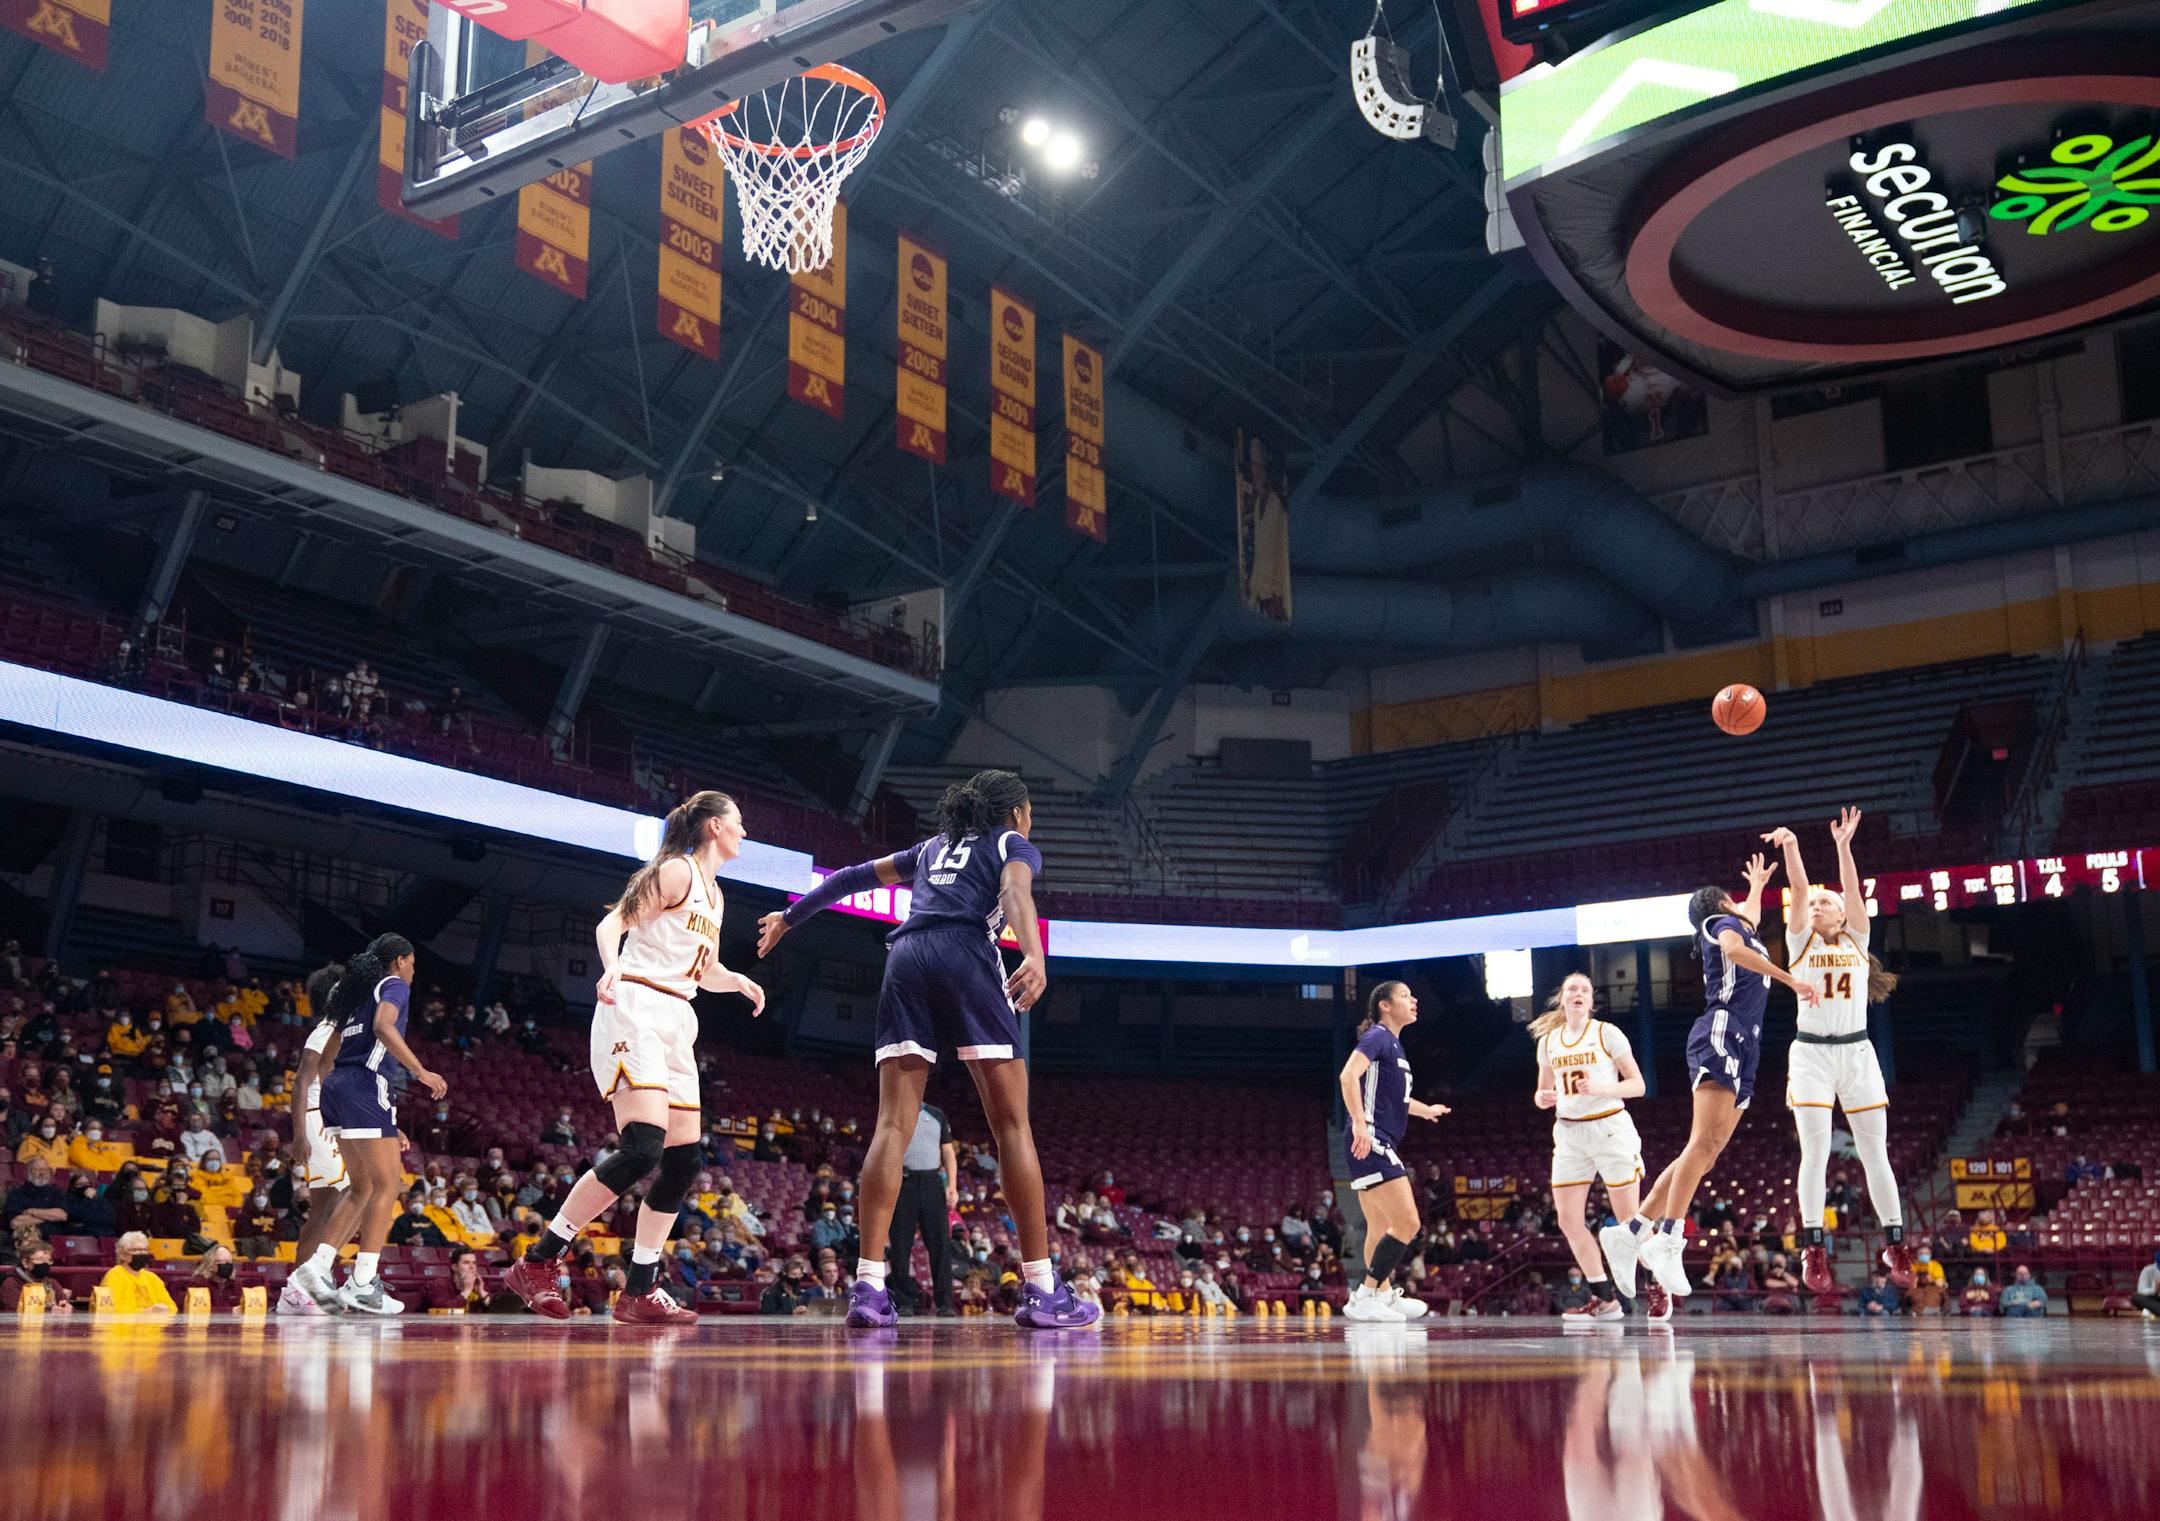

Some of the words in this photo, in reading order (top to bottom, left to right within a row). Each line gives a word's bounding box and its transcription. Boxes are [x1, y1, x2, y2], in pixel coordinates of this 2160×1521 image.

[673, 164, 715, 200] SWEET
[668, 181, 719, 223] SIXTEEN
[669, 222, 713, 264] 2003
[1826, 194, 1917, 292] FINANCIAL
[800, 290, 838, 330] 2004
[906, 292, 940, 322] SWEET
[902, 308, 943, 342] SIXTEEN
[904, 345, 940, 380] 2005
[929, 835, 979, 871] 15
[2086, 850, 2129, 869] FOULS
[1863, 878, 1877, 898] 7
[2044, 873, 2064, 898] 4
[2102, 868, 2120, 893] 5
[1823, 972, 1852, 999] 14
[1724, 1055, 1740, 1079] N
